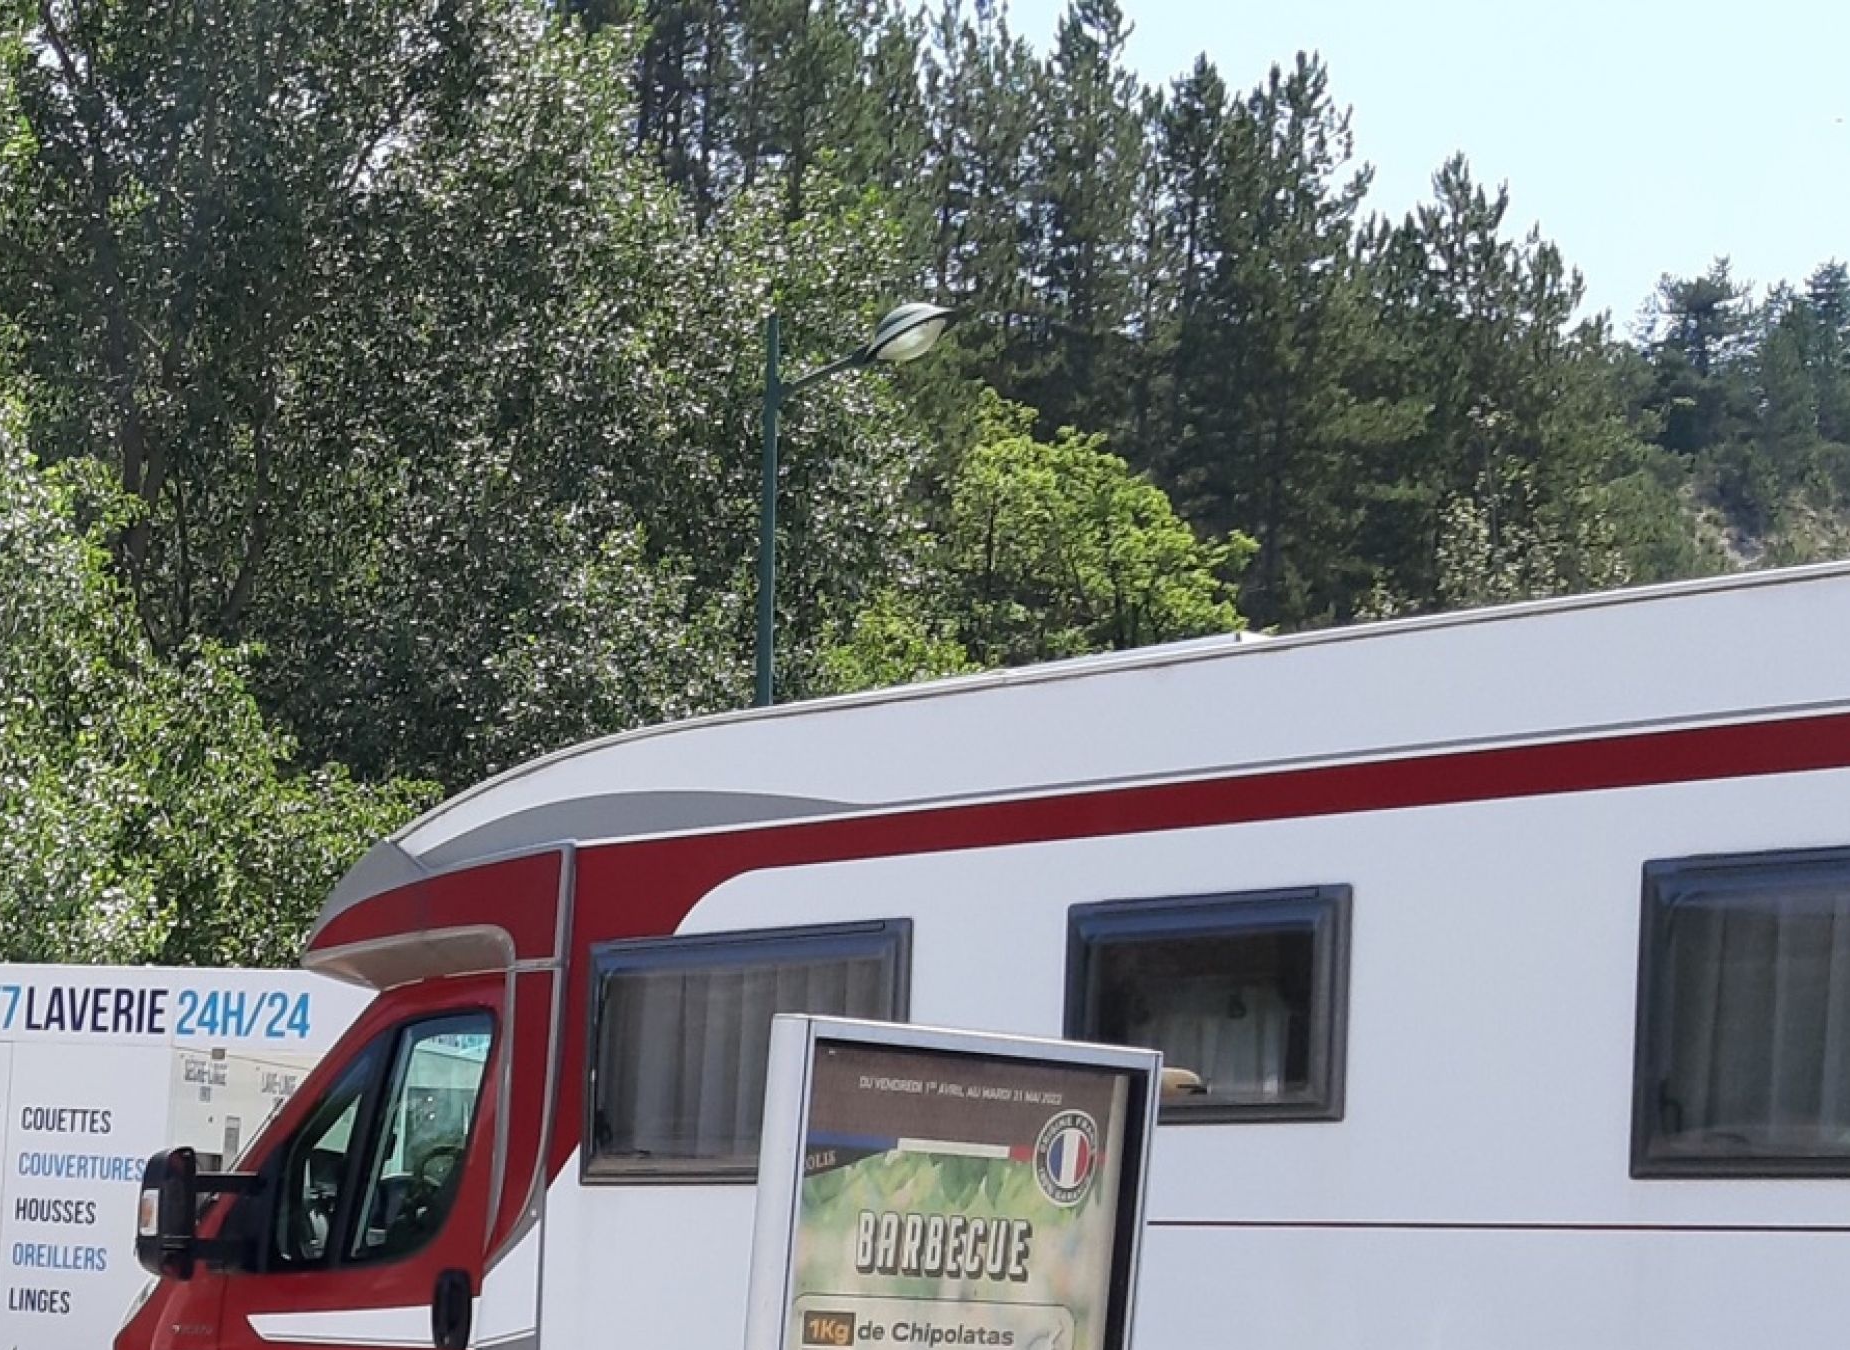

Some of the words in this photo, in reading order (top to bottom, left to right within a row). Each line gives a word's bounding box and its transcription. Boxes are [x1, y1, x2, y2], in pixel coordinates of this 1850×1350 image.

[24, 986, 169, 1035] LAVERIE
[175, 989, 311, 1039] 24H/24
[860, 1076, 872, 1089] DU
[874, 1077, 923, 1093] VENDREDI
[939, 1083, 965, 1098] AVRIL
[966, 1086, 981, 1098] AU
[982, 1087, 1011, 1100] MARDI
[21, 1106, 112, 1134] COUETTES
[18, 1152, 145, 1181] COUVERTURES
[14, 1198, 96, 1225] HOUSSES
[12, 1241, 108, 1272] OREILLERS
[855, 1210, 1033, 1282] BARBECUE
[8, 1287, 71, 1314] LINGES
[809, 1318, 850, 1345] 1Kg
[857, 1321, 885, 1341] de
[891, 1322, 1015, 1348] Chipolatas
